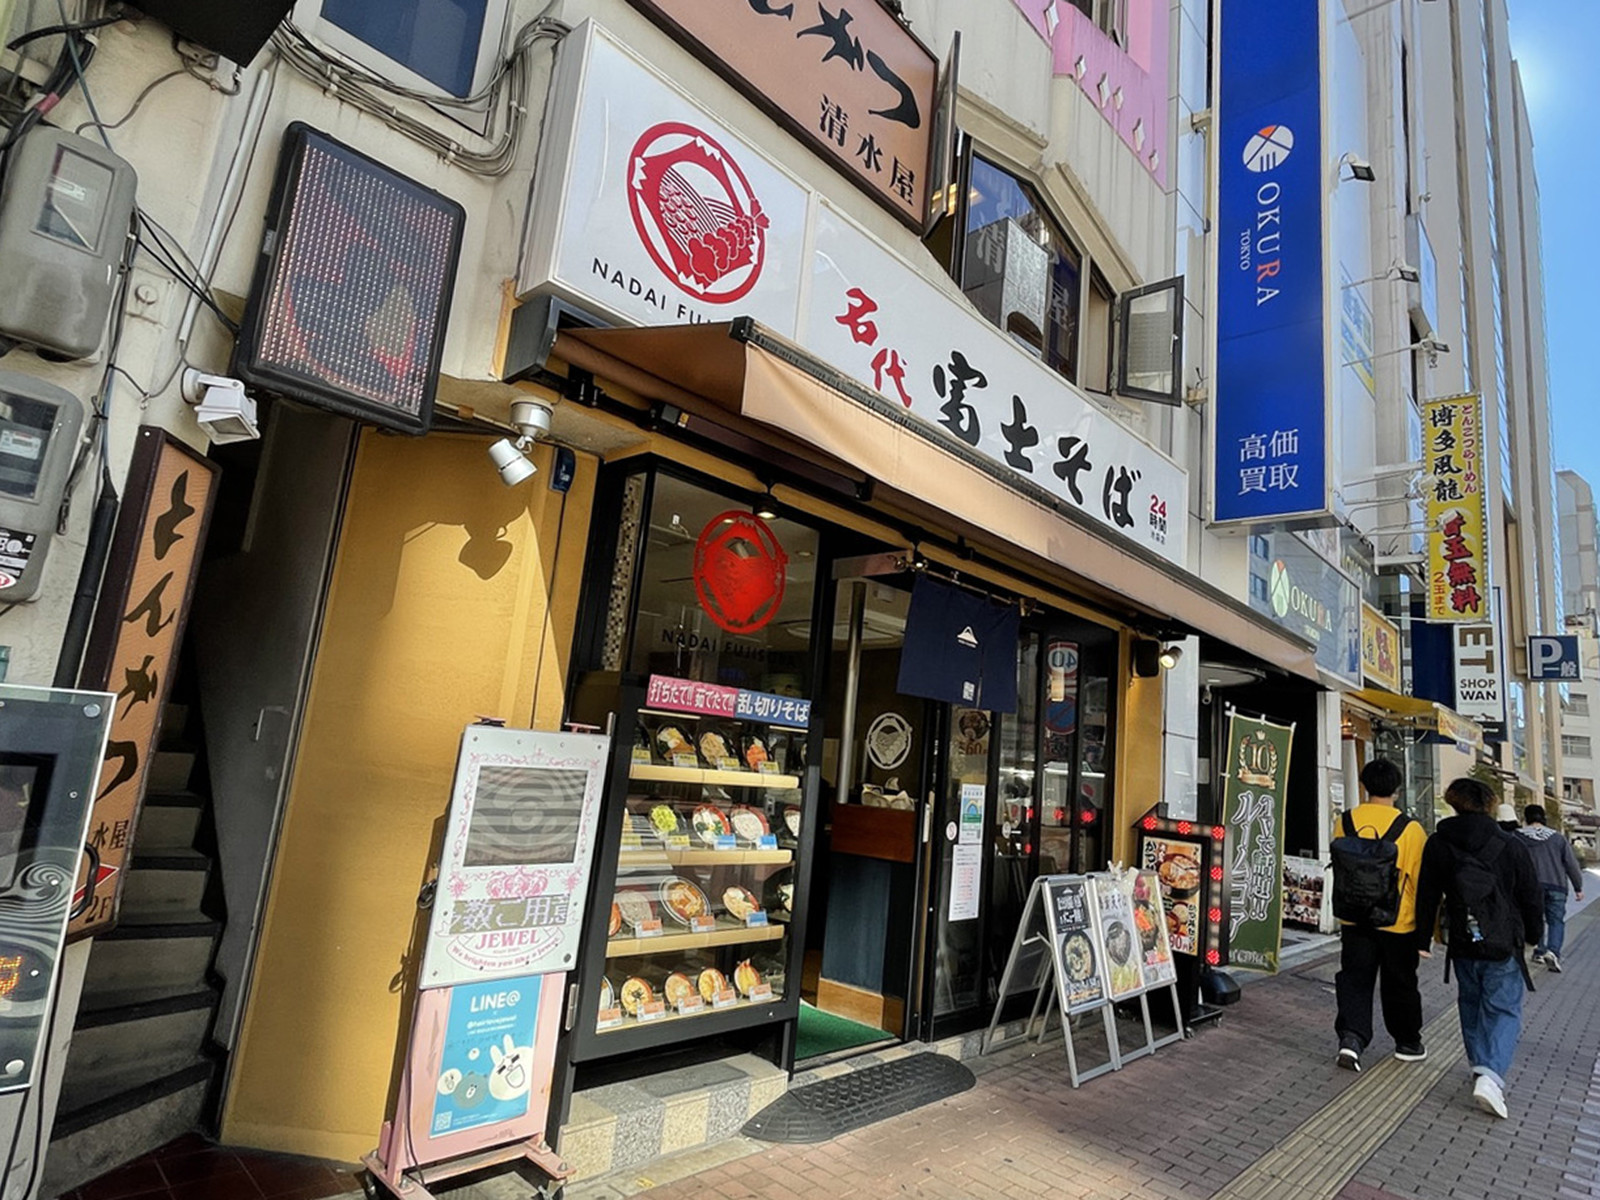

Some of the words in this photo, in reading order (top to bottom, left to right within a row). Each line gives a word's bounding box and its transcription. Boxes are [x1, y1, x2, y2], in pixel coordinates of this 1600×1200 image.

[819, 94, 916, 206] 清水屋
[1239, 228, 1251, 271] TOKYO
[1256, 181, 1282, 306] OKURA
[592, 257, 667, 311] NADAI
[676, 303, 712, 325] FU
[835, 287, 912, 408] 名代
[932, 350, 1142, 528] 富士そば
[1238, 428, 1300, 463] 高価
[1429, 404, 1465, 502] 博多風龍
[1461, 404, 1477, 494] とんこつらーめん
[1238, 463, 1300, 497] 買取
[1150, 494, 1167, 518] 24
[1149, 513, 1167, 535] 時間
[1290, 584, 1333, 633] OKURA
[1433, 571, 1446, 616] 2玉まで
[662, 629, 717, 652] NADAI
[1460, 678, 1496, 689] SHOP
[1543, 661, 1577, 678] 一般
[737, 692, 811, 722] 乱切りそば
[1460, 690, 1497, 701] WAN
[1248, 743, 1270, 773] 10
[84, 894, 112, 924] 2F
[475, 929, 541, 951] JEWEL
[470, 989, 521, 1013] LINE@
